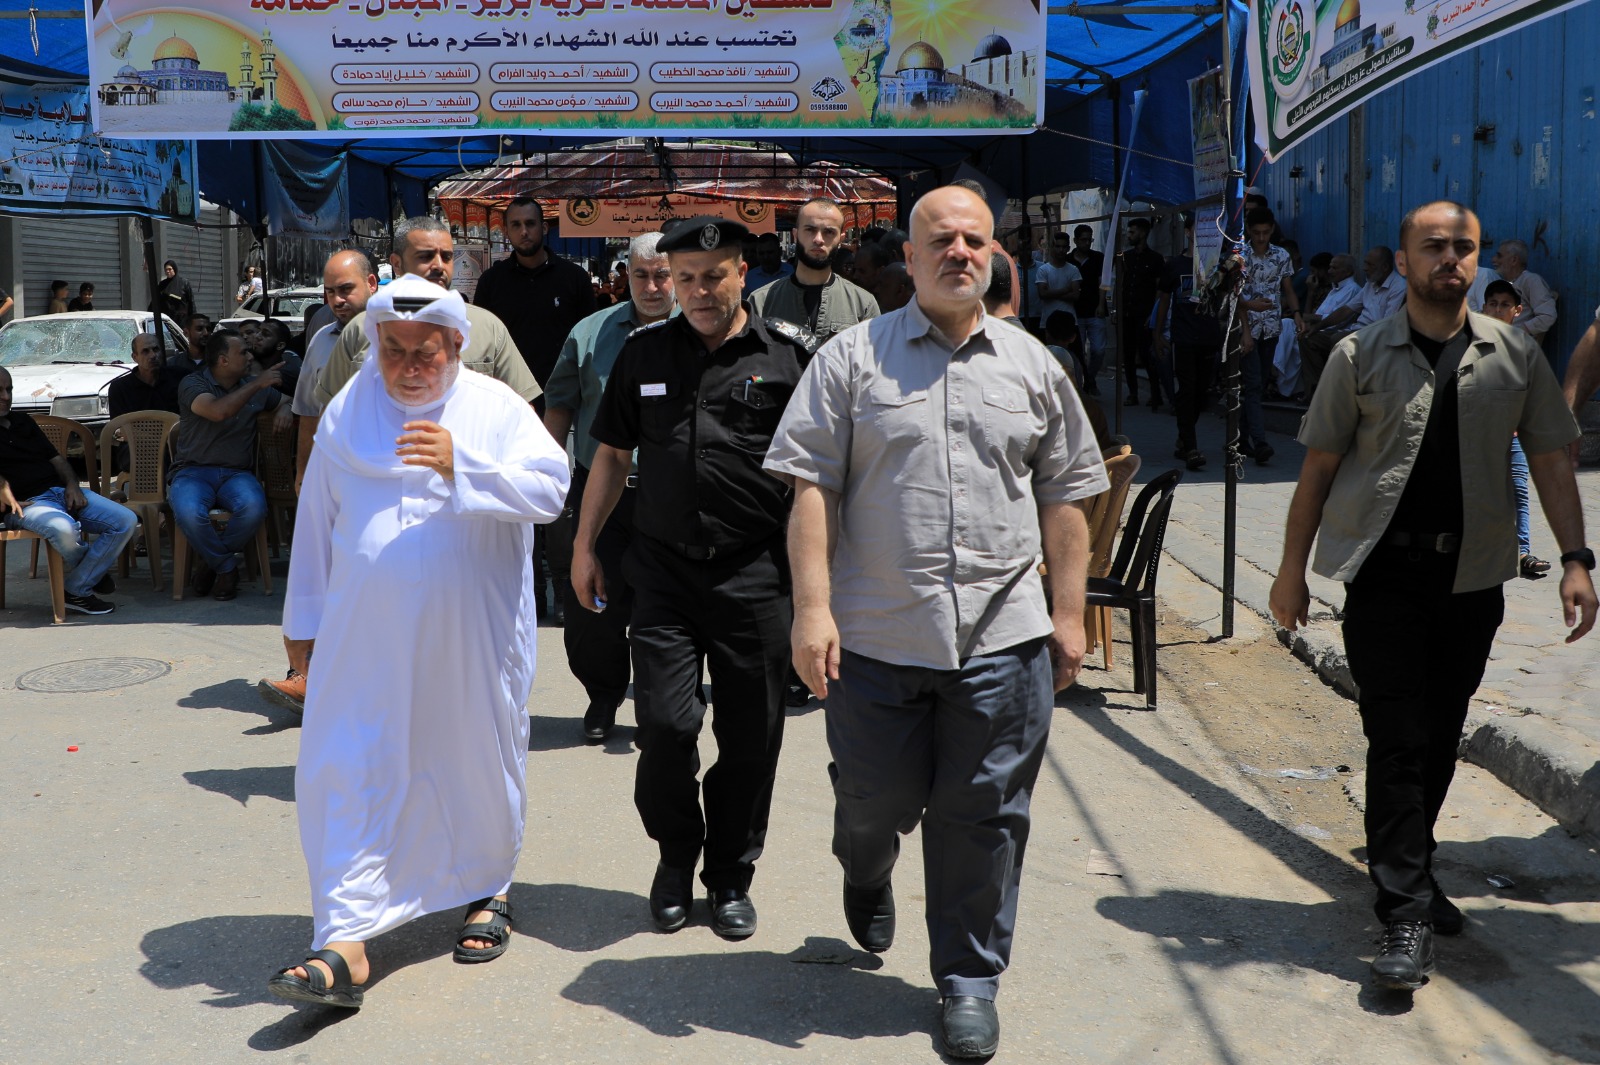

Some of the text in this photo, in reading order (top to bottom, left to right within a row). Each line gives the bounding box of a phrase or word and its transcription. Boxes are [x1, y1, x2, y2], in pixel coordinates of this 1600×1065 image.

[406, 31, 439, 48] منا
[446, 26, 527, 52] الأكرم
[533, 29, 616, 51] الشهداء
[622, 28, 658, 47] الله
[666, 30, 709, 47] عند
[1385, 45, 1406, 64] سائلين
[548, 64, 584, 78] أحمد
[1365, 54, 1385, 75] المولى
[342, 69, 373, 80] حمادة
[393, 69, 426, 81] خليل
[434, 67, 471, 80] الشهيد
[526, 68, 546, 80] وليد
[592, 66, 628, 80] الشهيد
[659, 67, 695, 79] الخطيب
[697, 69, 724, 77] محمد
[726, 66, 746, 77] نافذ
[754, 65, 790, 79] الشهيد
[341, 98, 364, 109] سالم
[366, 99, 393, 107] محمد
[394, 97, 427, 109] حازم
[435, 95, 471, 109] الشهيد
[498, 97, 525, 109] النيرب
[527, 98, 554, 107] محمد
[555, 94, 586, 108] مؤمن
[595, 94, 630, 108] الشهيد
[656, 98, 682, 110] النيرب
[685, 100, 712, 108] محمد
[715, 94, 747, 108] أحمد
[754, 96, 790, 110] الشهيد
[437, 116, 470, 125] الشهيد
[651, 195, 691, 209] القس
[612, 212, 630, 224] شعبنا
[631, 213, 644, 223] على
